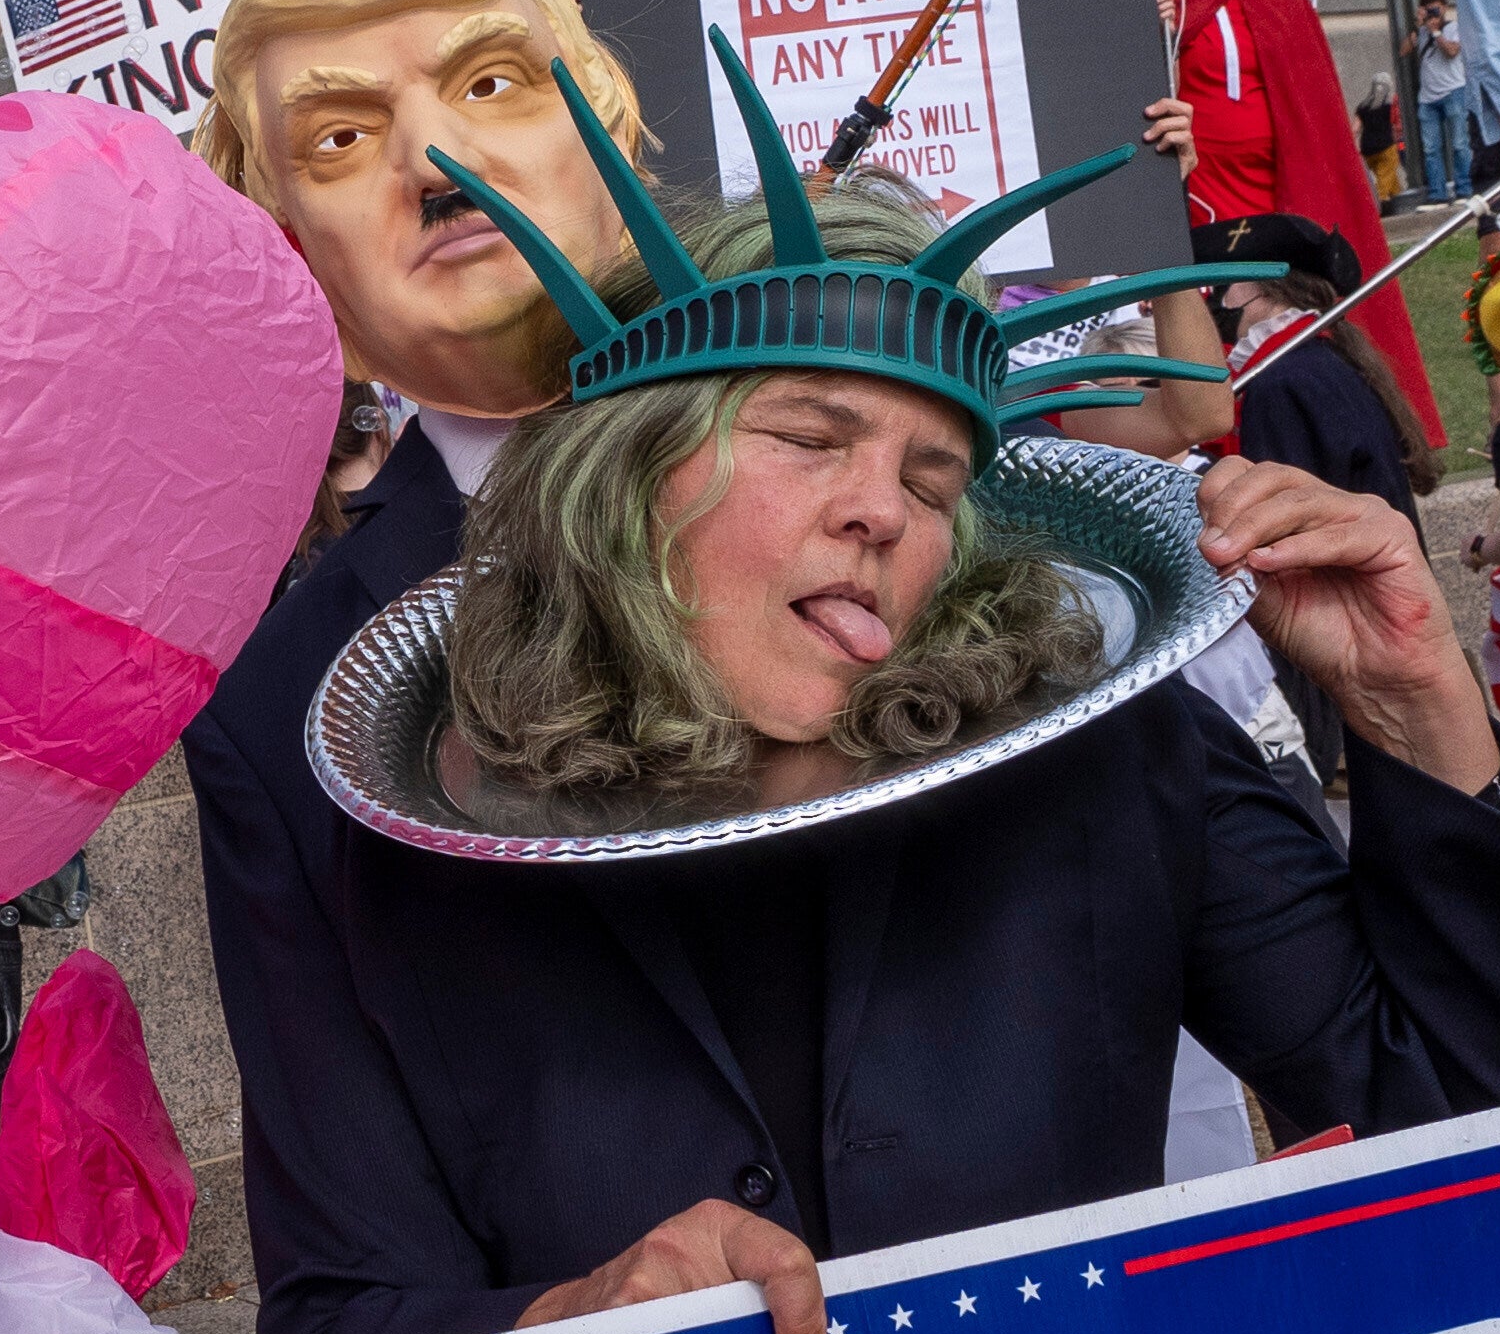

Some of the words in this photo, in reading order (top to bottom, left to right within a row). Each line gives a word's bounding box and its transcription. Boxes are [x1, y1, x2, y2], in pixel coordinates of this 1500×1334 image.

[772, 36, 848, 86] ANY
[919, 101, 981, 139] WILL
[859, 143, 956, 178] EMOVED
